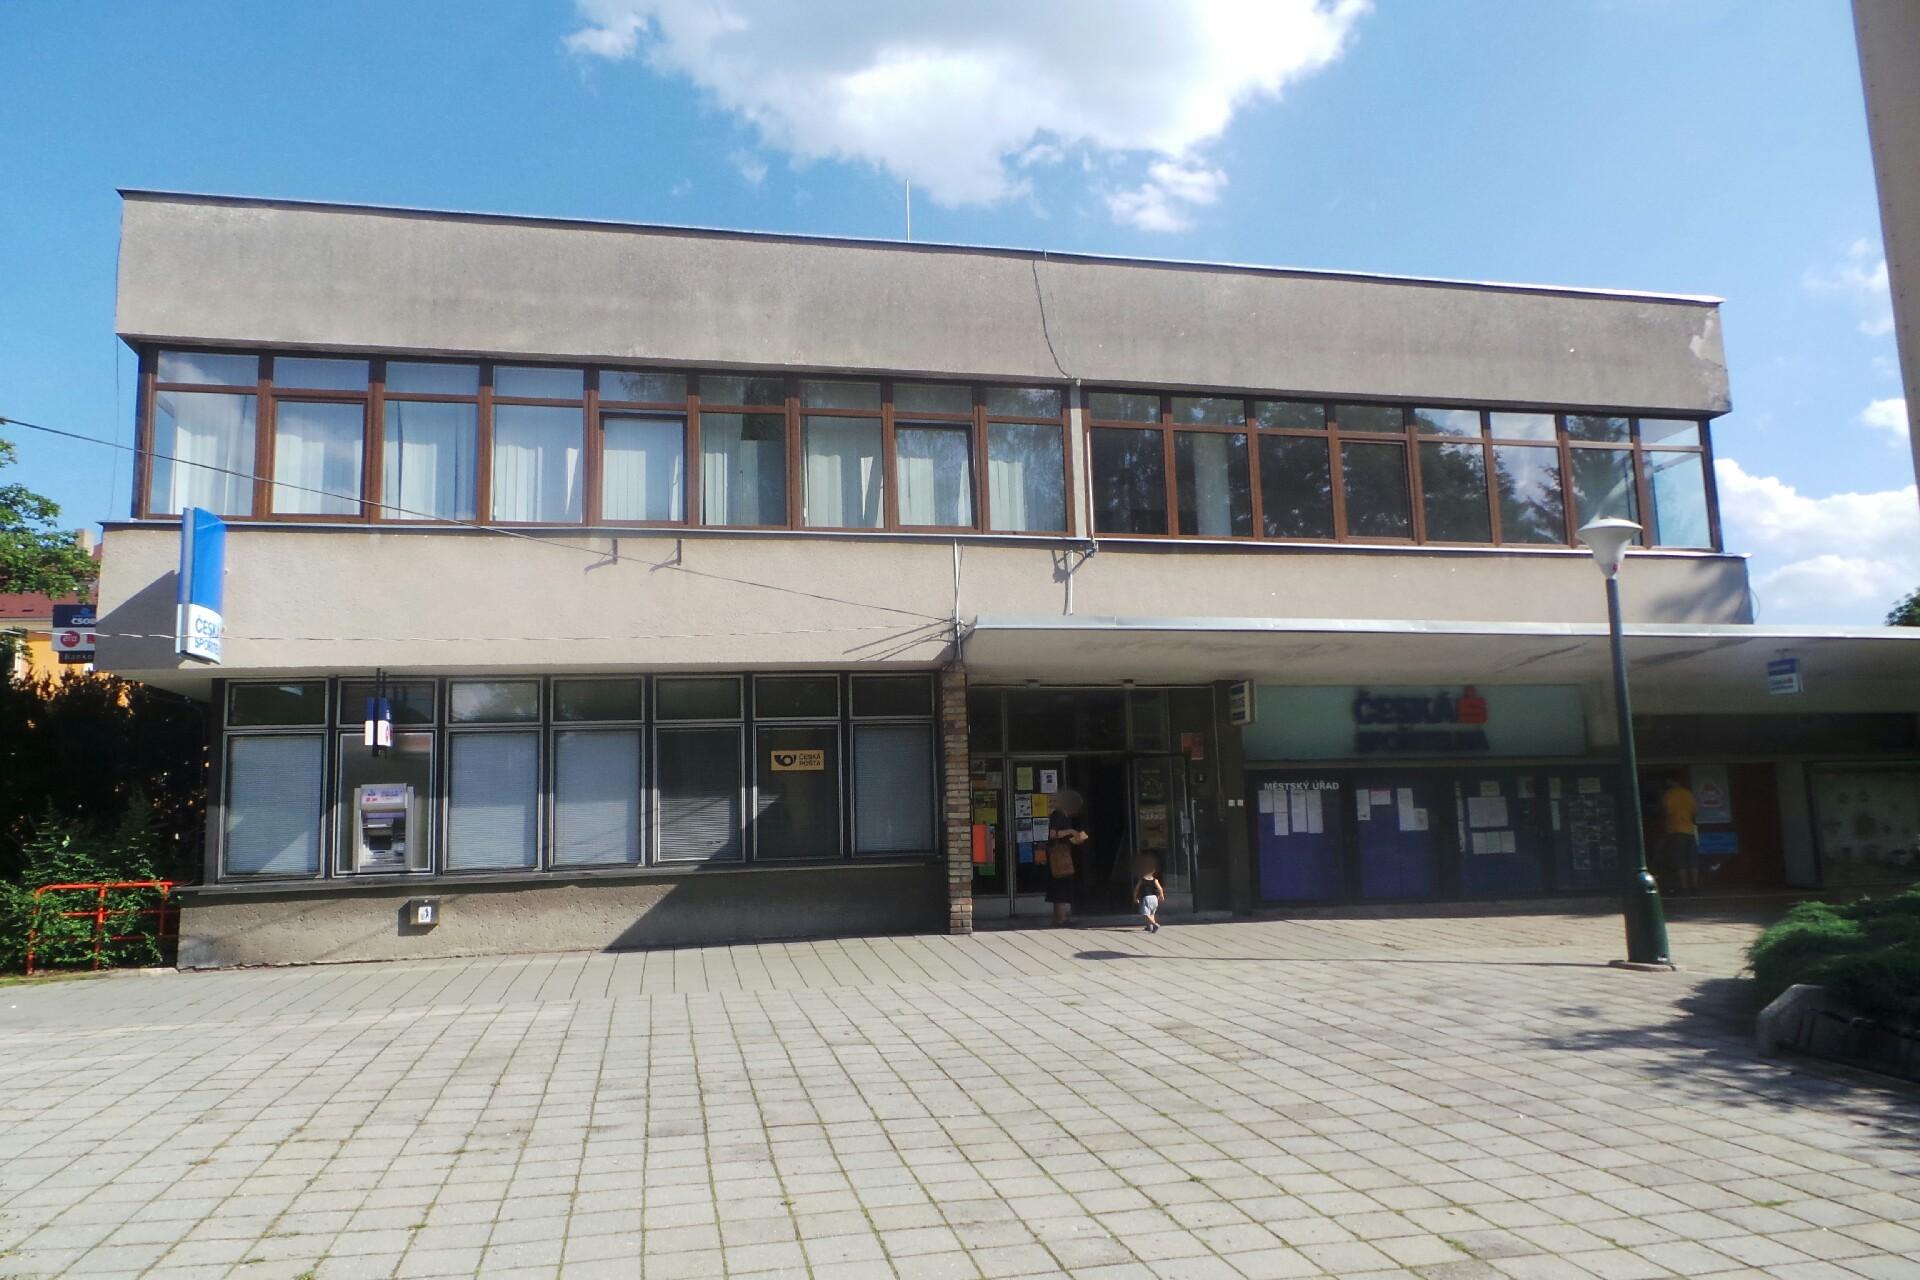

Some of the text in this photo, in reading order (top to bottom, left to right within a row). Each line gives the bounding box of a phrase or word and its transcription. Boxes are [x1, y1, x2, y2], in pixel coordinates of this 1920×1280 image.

[799, 752, 821, 760] ČESKÁ
[799, 759, 821, 767] POŠTA
[1264, 780, 1340, 791] MĚSTSKÝ ÚŘAD
